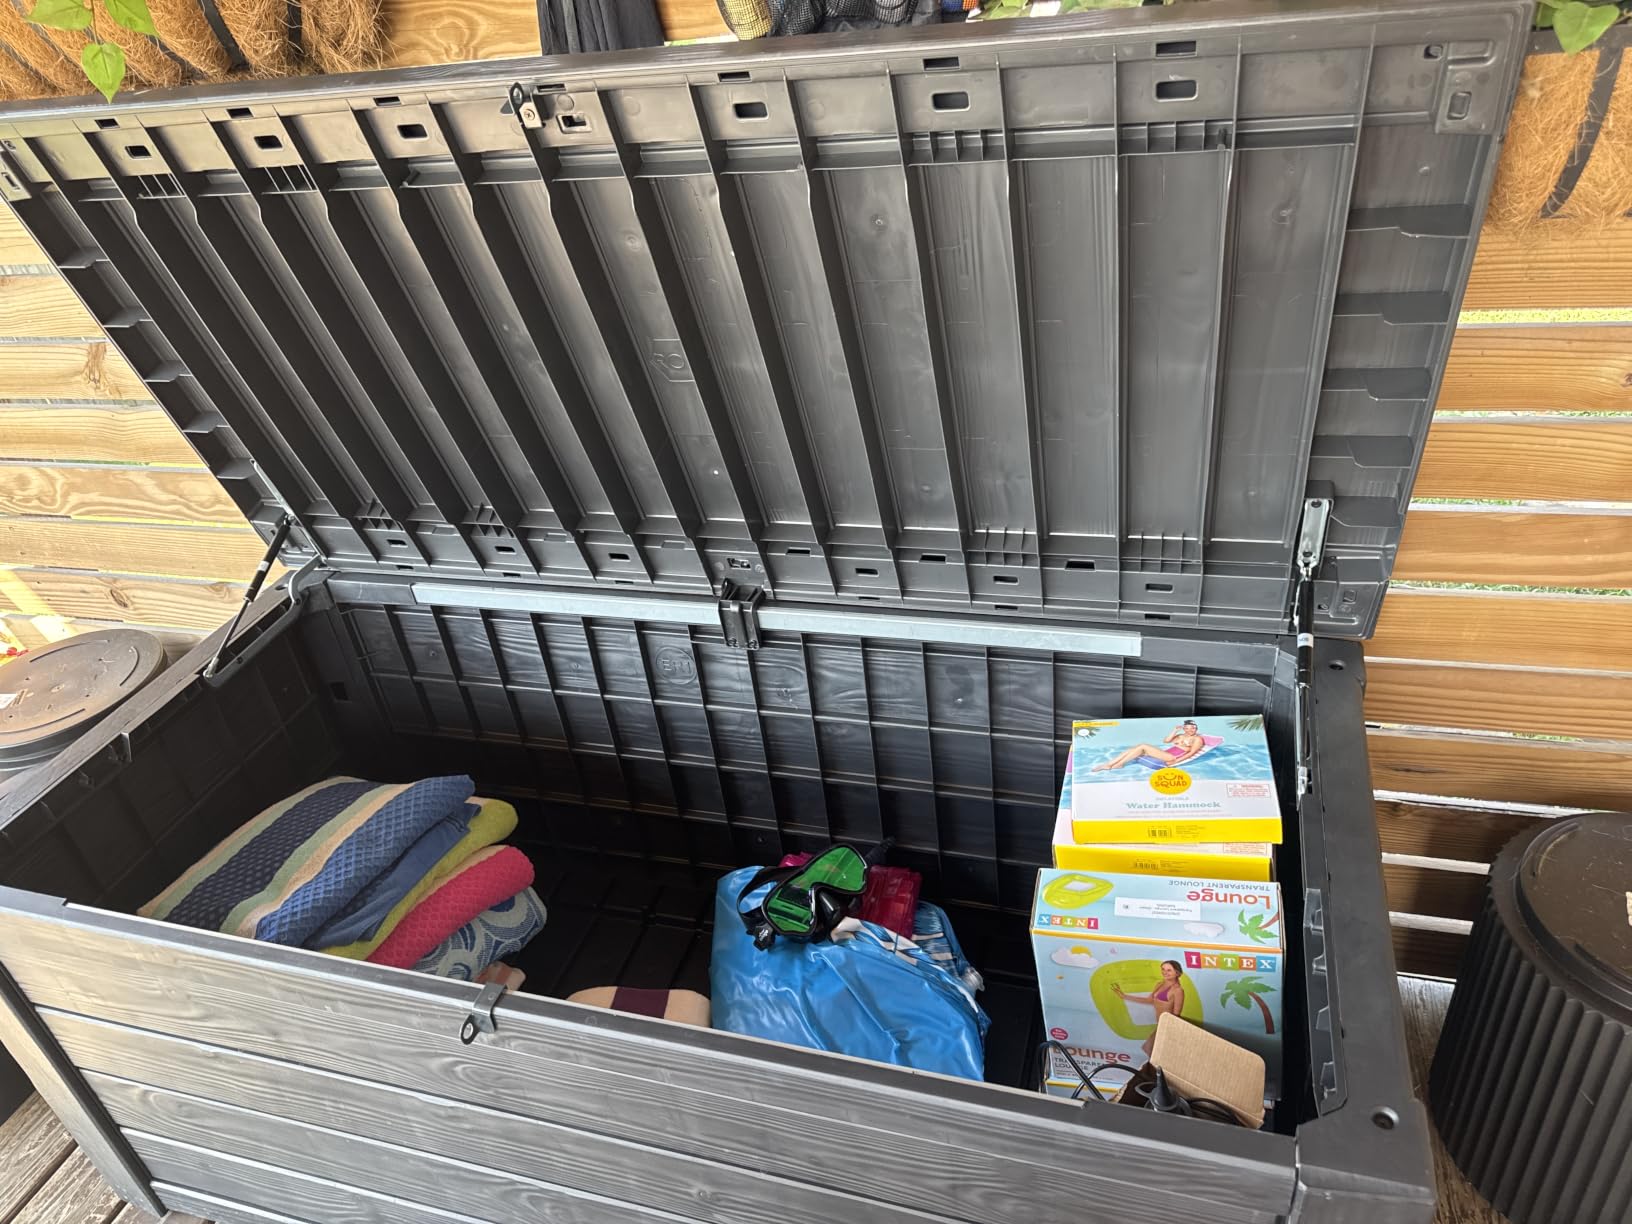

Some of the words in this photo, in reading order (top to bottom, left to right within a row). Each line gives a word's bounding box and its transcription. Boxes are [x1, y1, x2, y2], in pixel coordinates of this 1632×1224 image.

[1154, 780, 1188, 788] SQUAD
[1163, 800, 1222, 809] Hammock
[1168, 879, 1205, 888] LOUNGE
[1207, 879, 1271, 891] TRANSPARENT
[1186, 888, 1271, 909] Lounge
[1039, 915, 1096, 928] INTEX
[1188, 954, 1275, 971] INTEX
